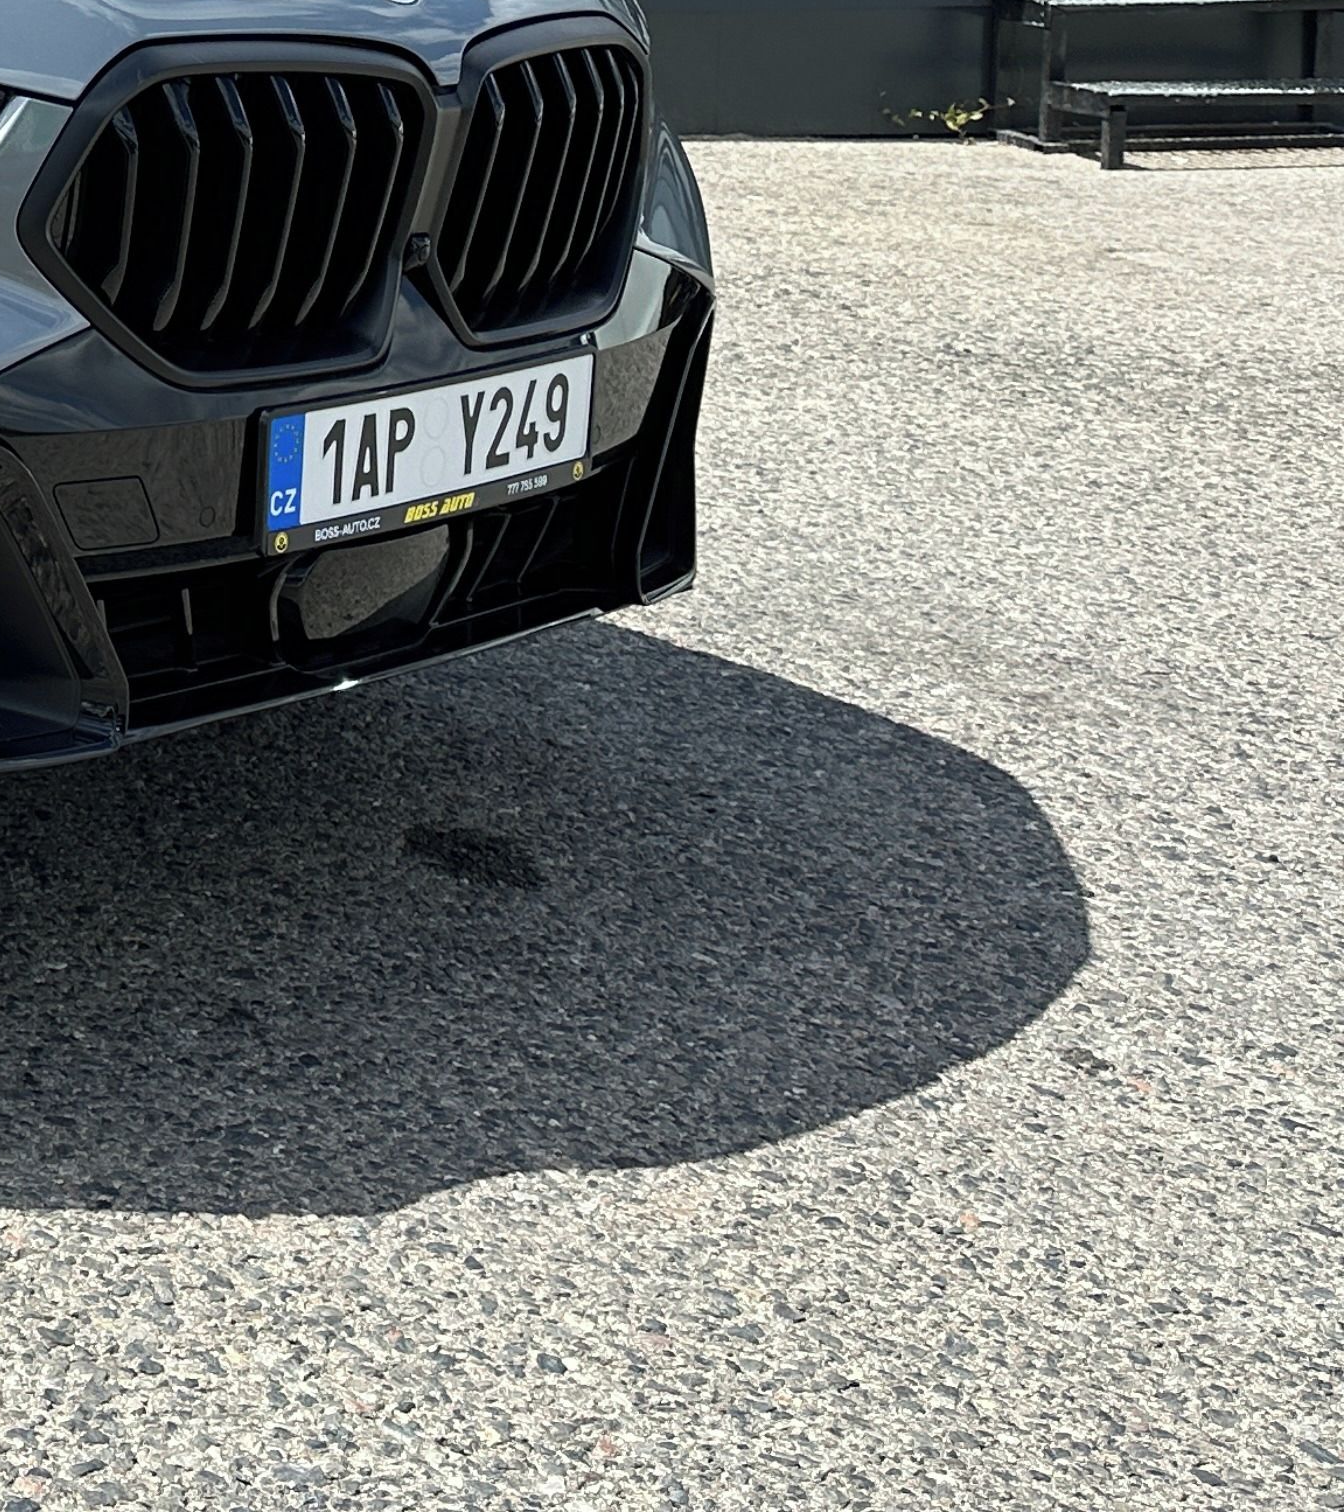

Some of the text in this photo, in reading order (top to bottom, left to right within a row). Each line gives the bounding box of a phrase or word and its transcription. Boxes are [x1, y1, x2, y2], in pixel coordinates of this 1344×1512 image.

[322, 373, 570, 505] 1AP Y249
[270, 488, 297, 516] CZ
[404, 501, 439, 524] BOSS
[439, 492, 476, 517] AUTO
